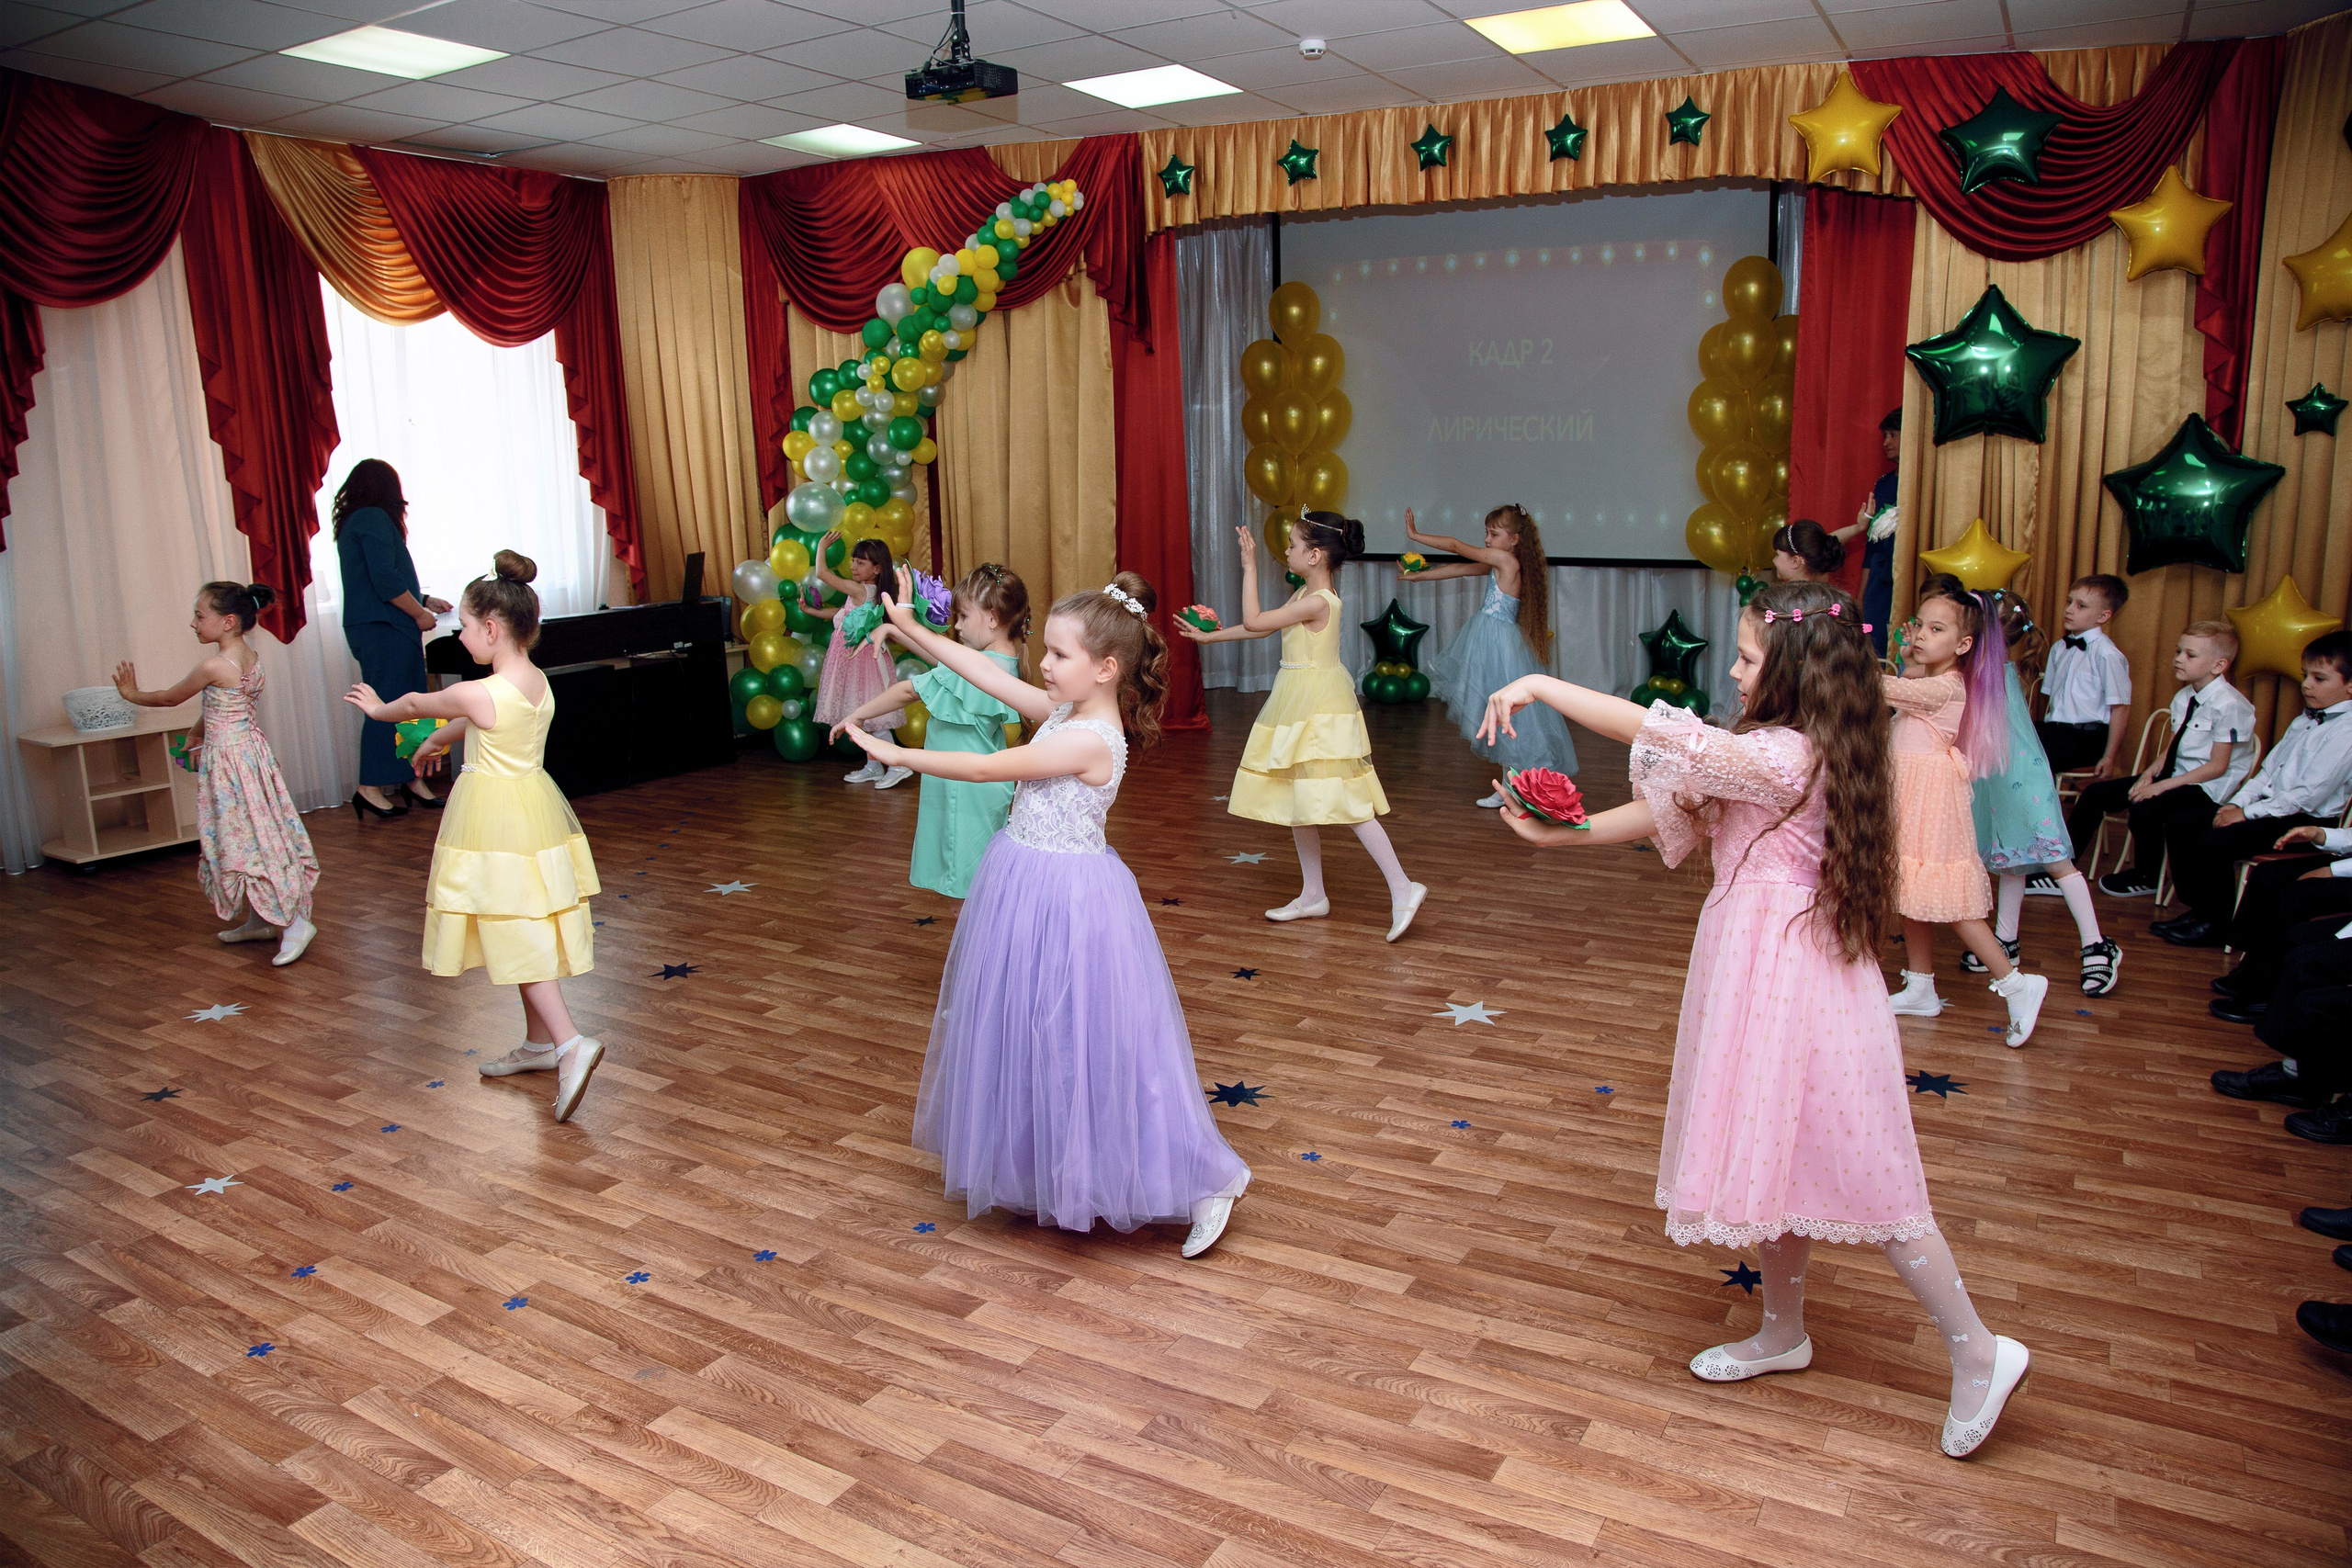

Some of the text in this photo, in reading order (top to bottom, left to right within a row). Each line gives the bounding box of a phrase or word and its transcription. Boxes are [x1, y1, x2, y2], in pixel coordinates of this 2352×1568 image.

[1469, 337, 1554, 369] КАДР 2
[1428, 409, 1594, 442] ЛИРИЧЕСКИЙ
